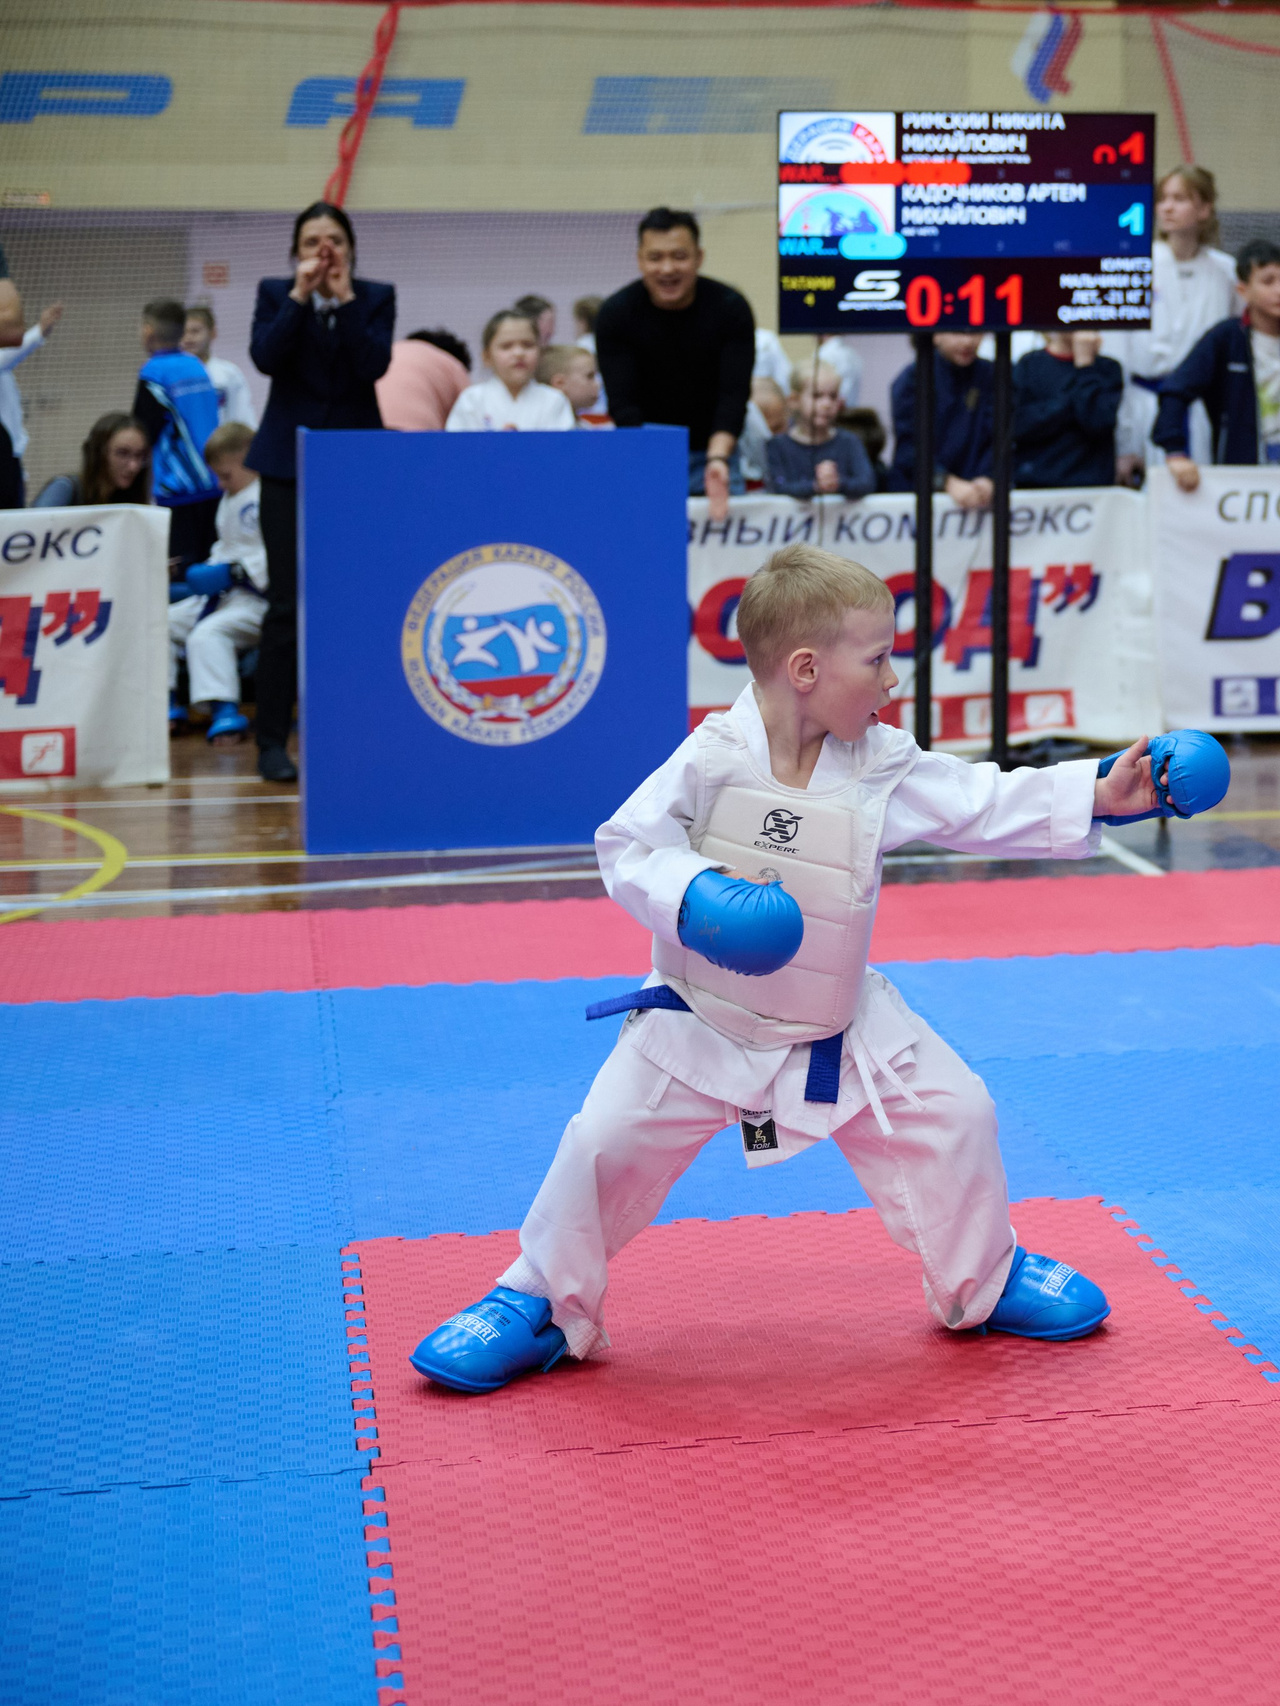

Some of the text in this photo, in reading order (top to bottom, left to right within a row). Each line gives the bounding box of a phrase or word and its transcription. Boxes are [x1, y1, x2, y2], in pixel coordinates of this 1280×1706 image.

[902, 131, 1027, 153] МИХАЙЛОВИЧ
[902, 184, 1086, 206] КАДОЧНИКОВ АРТЕМ
[902, 203, 1027, 225] МИХАЙЛОВИЧ
[1118, 202, 1145, 235] 1
[905, 274, 1023, 327] 0:11
[408, 551, 483, 632] ФЕДЕРАЦИЯ
[752, 1142, 770, 1150] TORI
